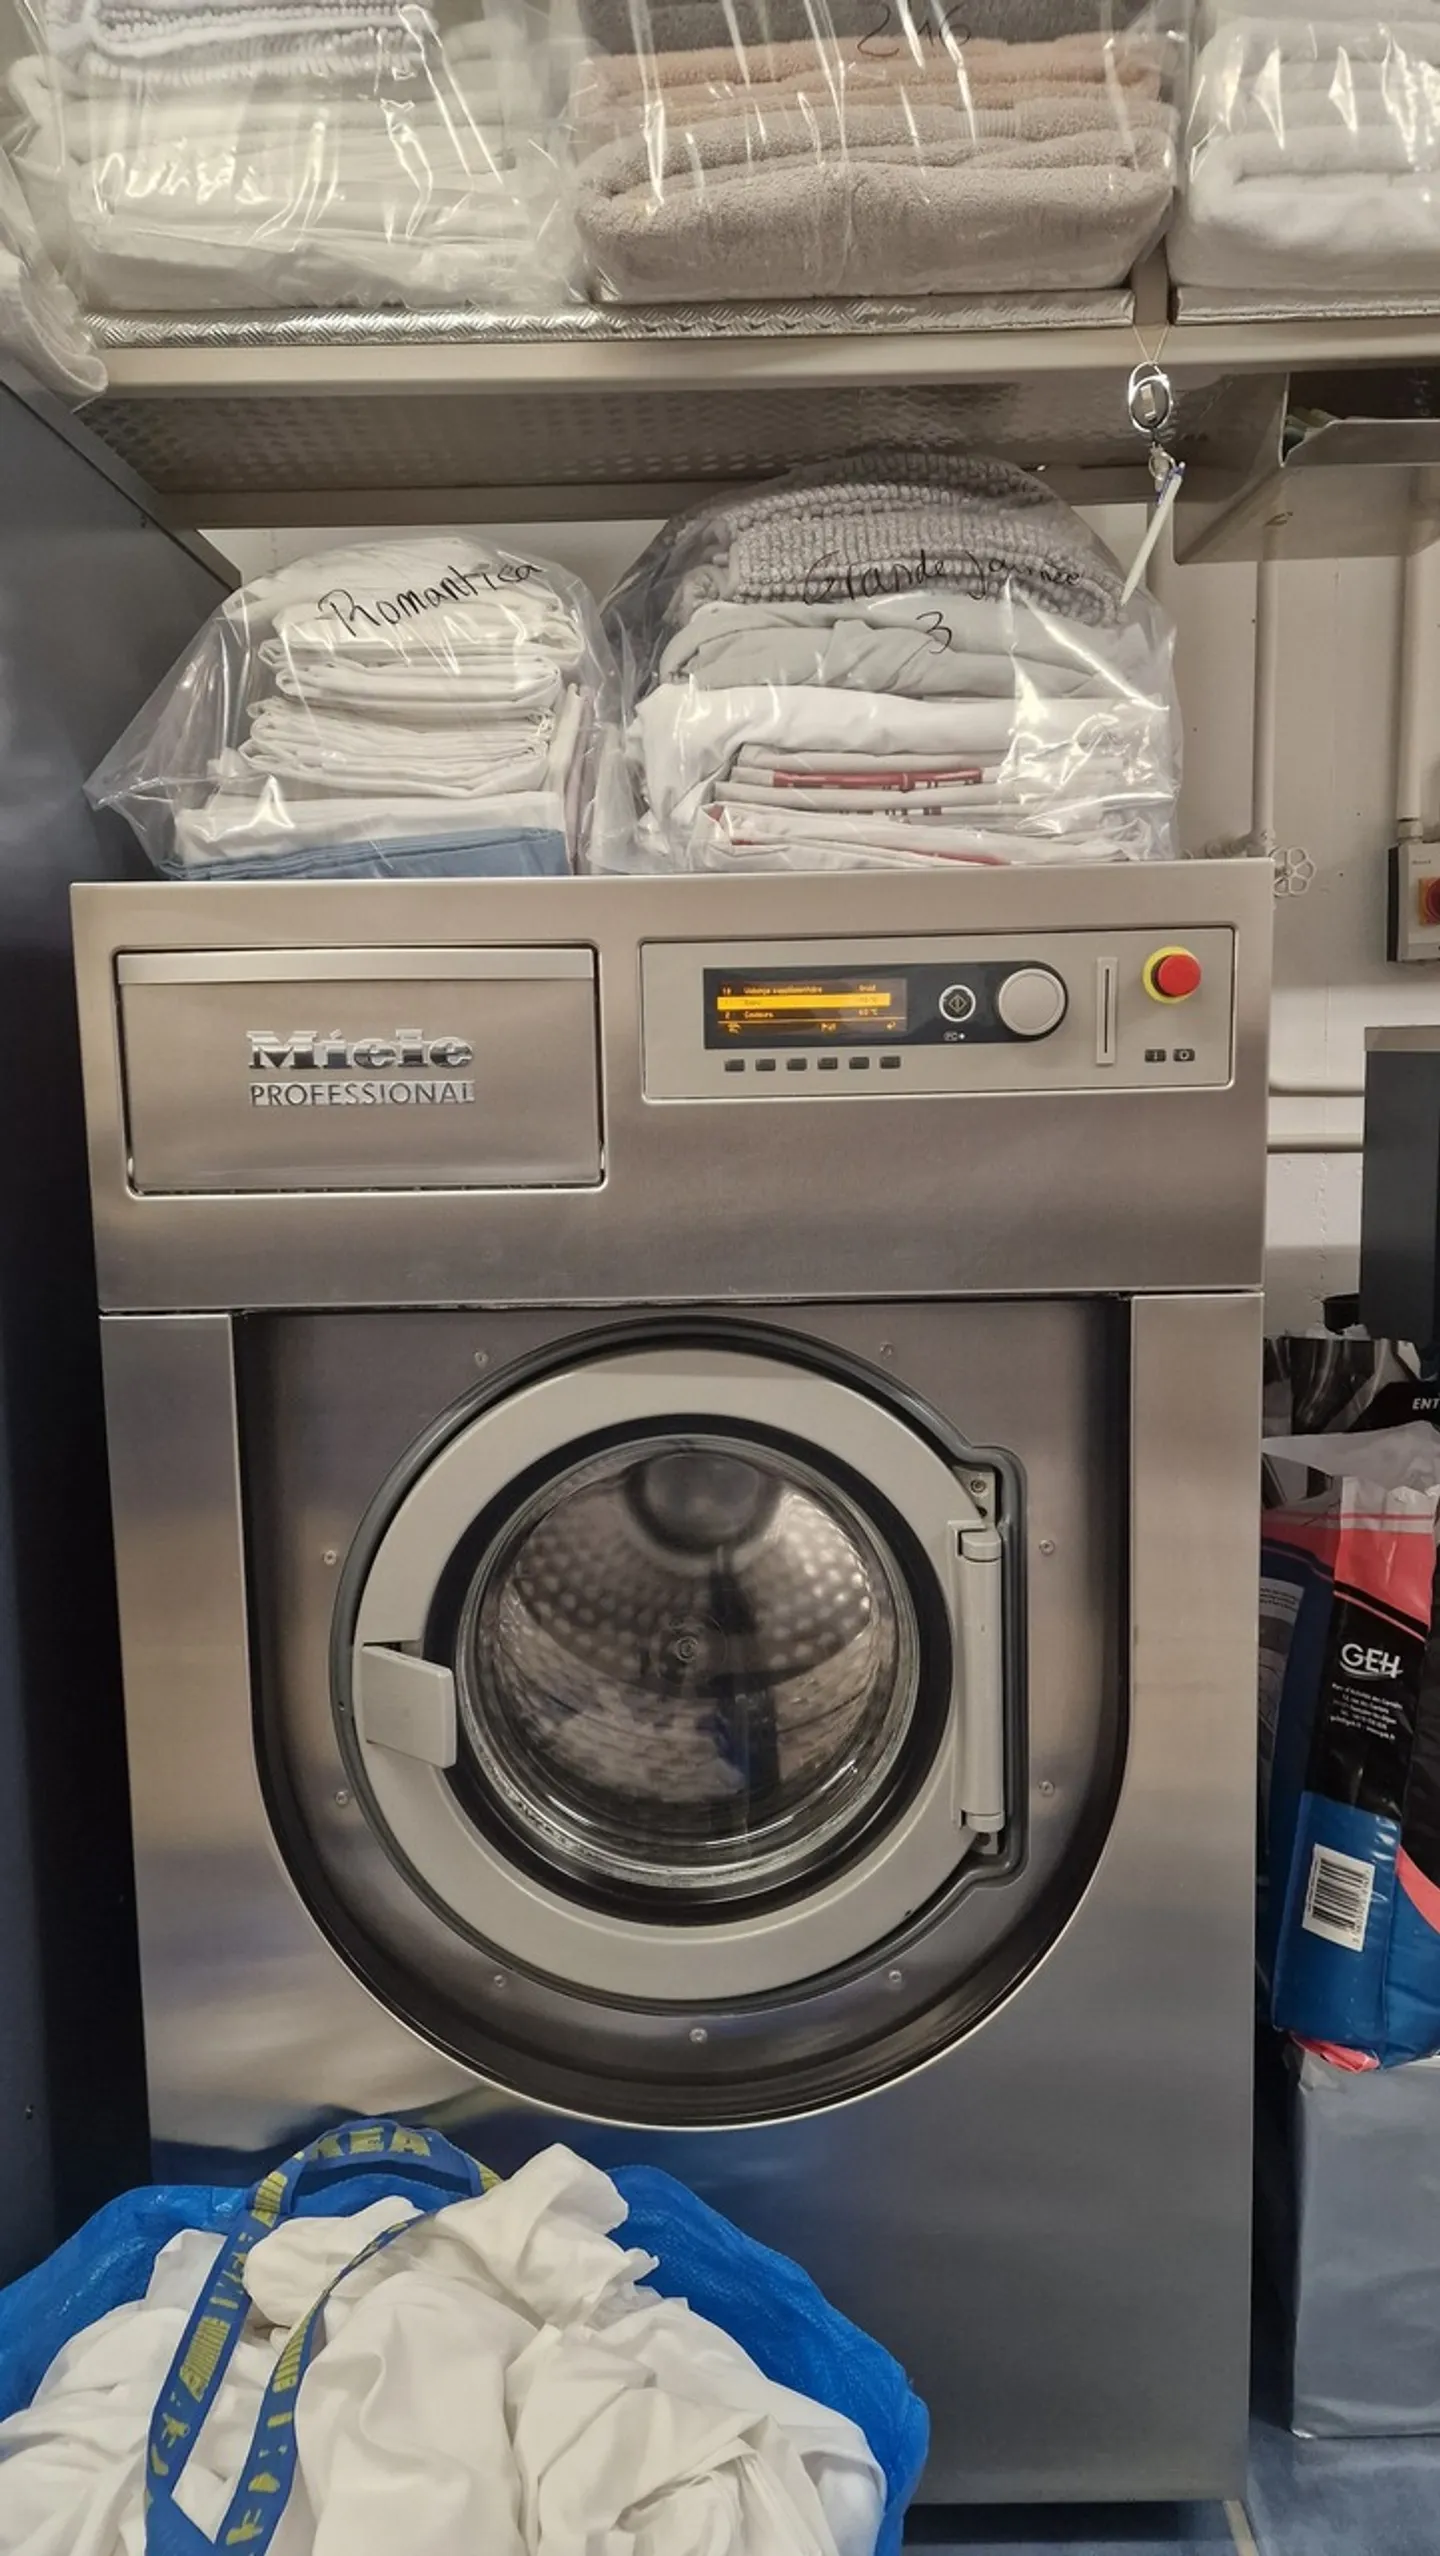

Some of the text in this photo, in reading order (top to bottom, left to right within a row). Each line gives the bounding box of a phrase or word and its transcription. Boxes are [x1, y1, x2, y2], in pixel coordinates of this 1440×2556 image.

[803, 548, 945, 605] Grande
[317, 563, 544, 637] Romantica
[916, 611, 952, 655] 3
[246, 1029, 475, 1070] Miele
[250, 1080, 475, 1107] PROFESSIONAL
[1341, 1643, 1401, 1679] GEH
